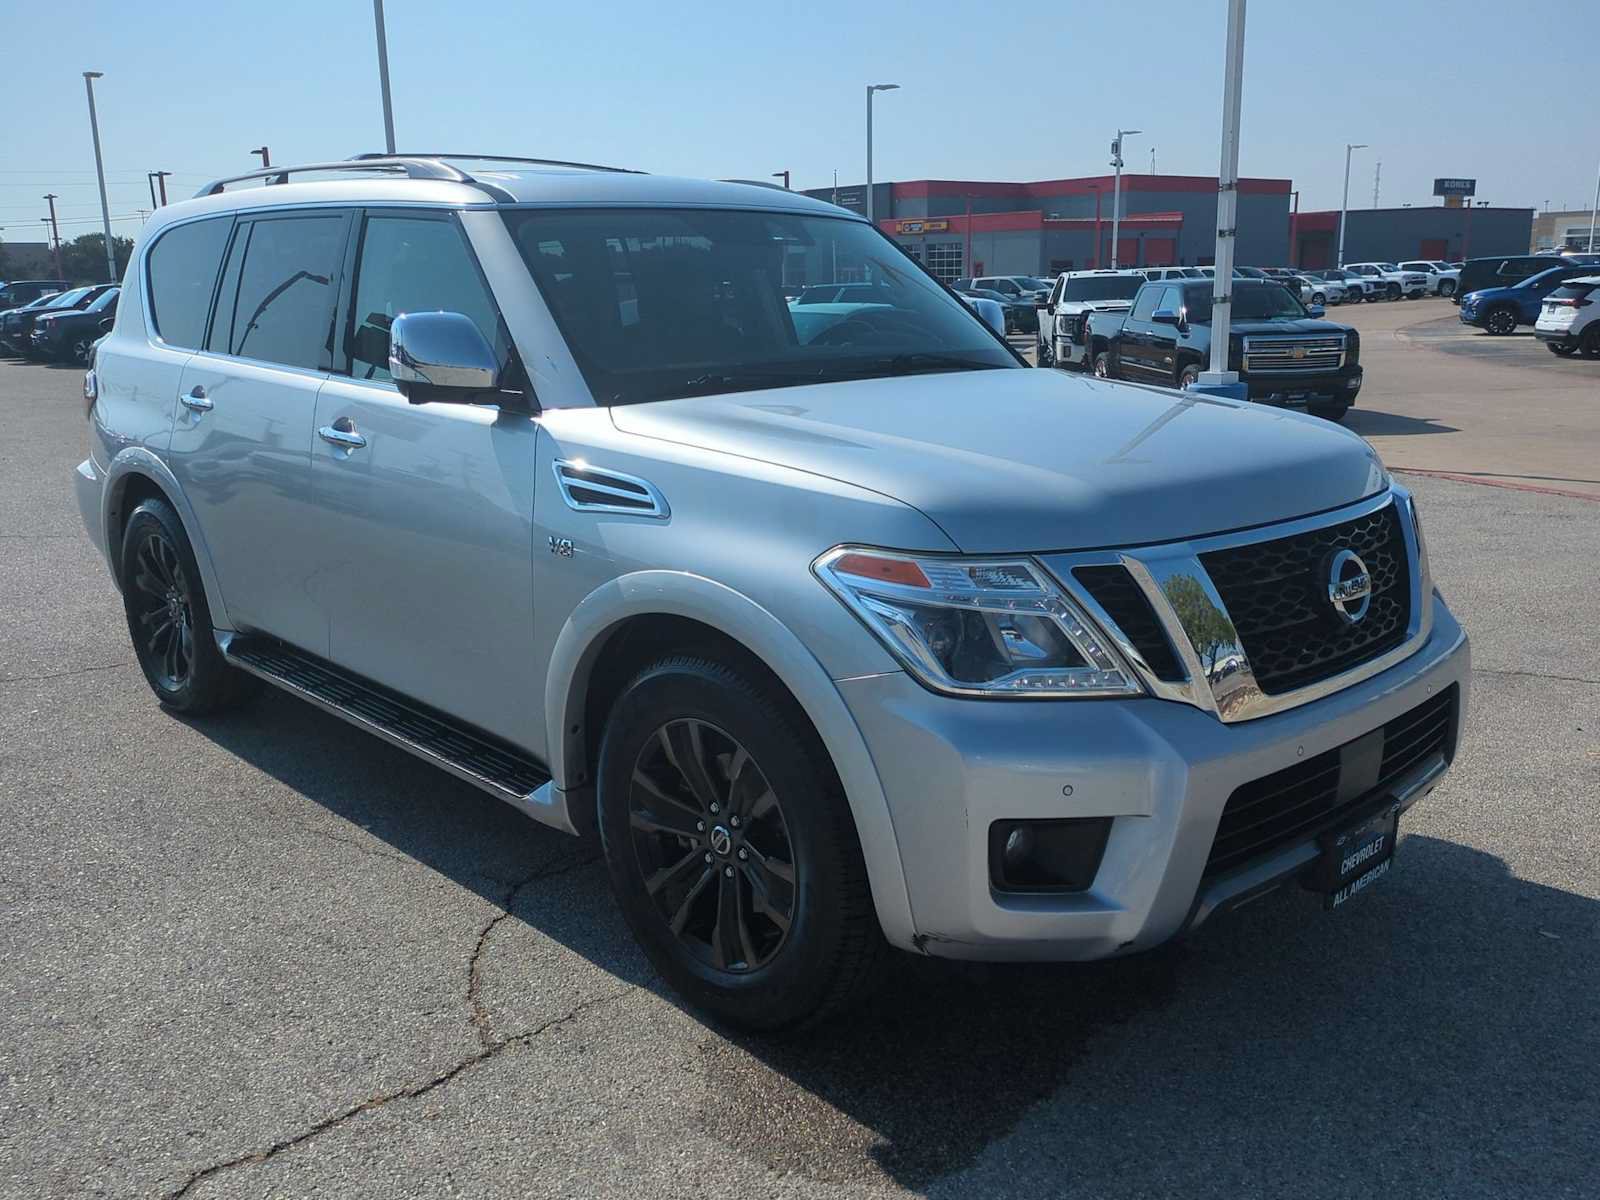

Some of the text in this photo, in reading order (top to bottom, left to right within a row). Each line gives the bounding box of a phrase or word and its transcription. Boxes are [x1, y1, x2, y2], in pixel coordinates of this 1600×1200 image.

[549, 535, 572, 558] V8
[1341, 835, 1385, 875] CHEVROLET
[1333, 858, 1391, 908] ALL AMERICAN
